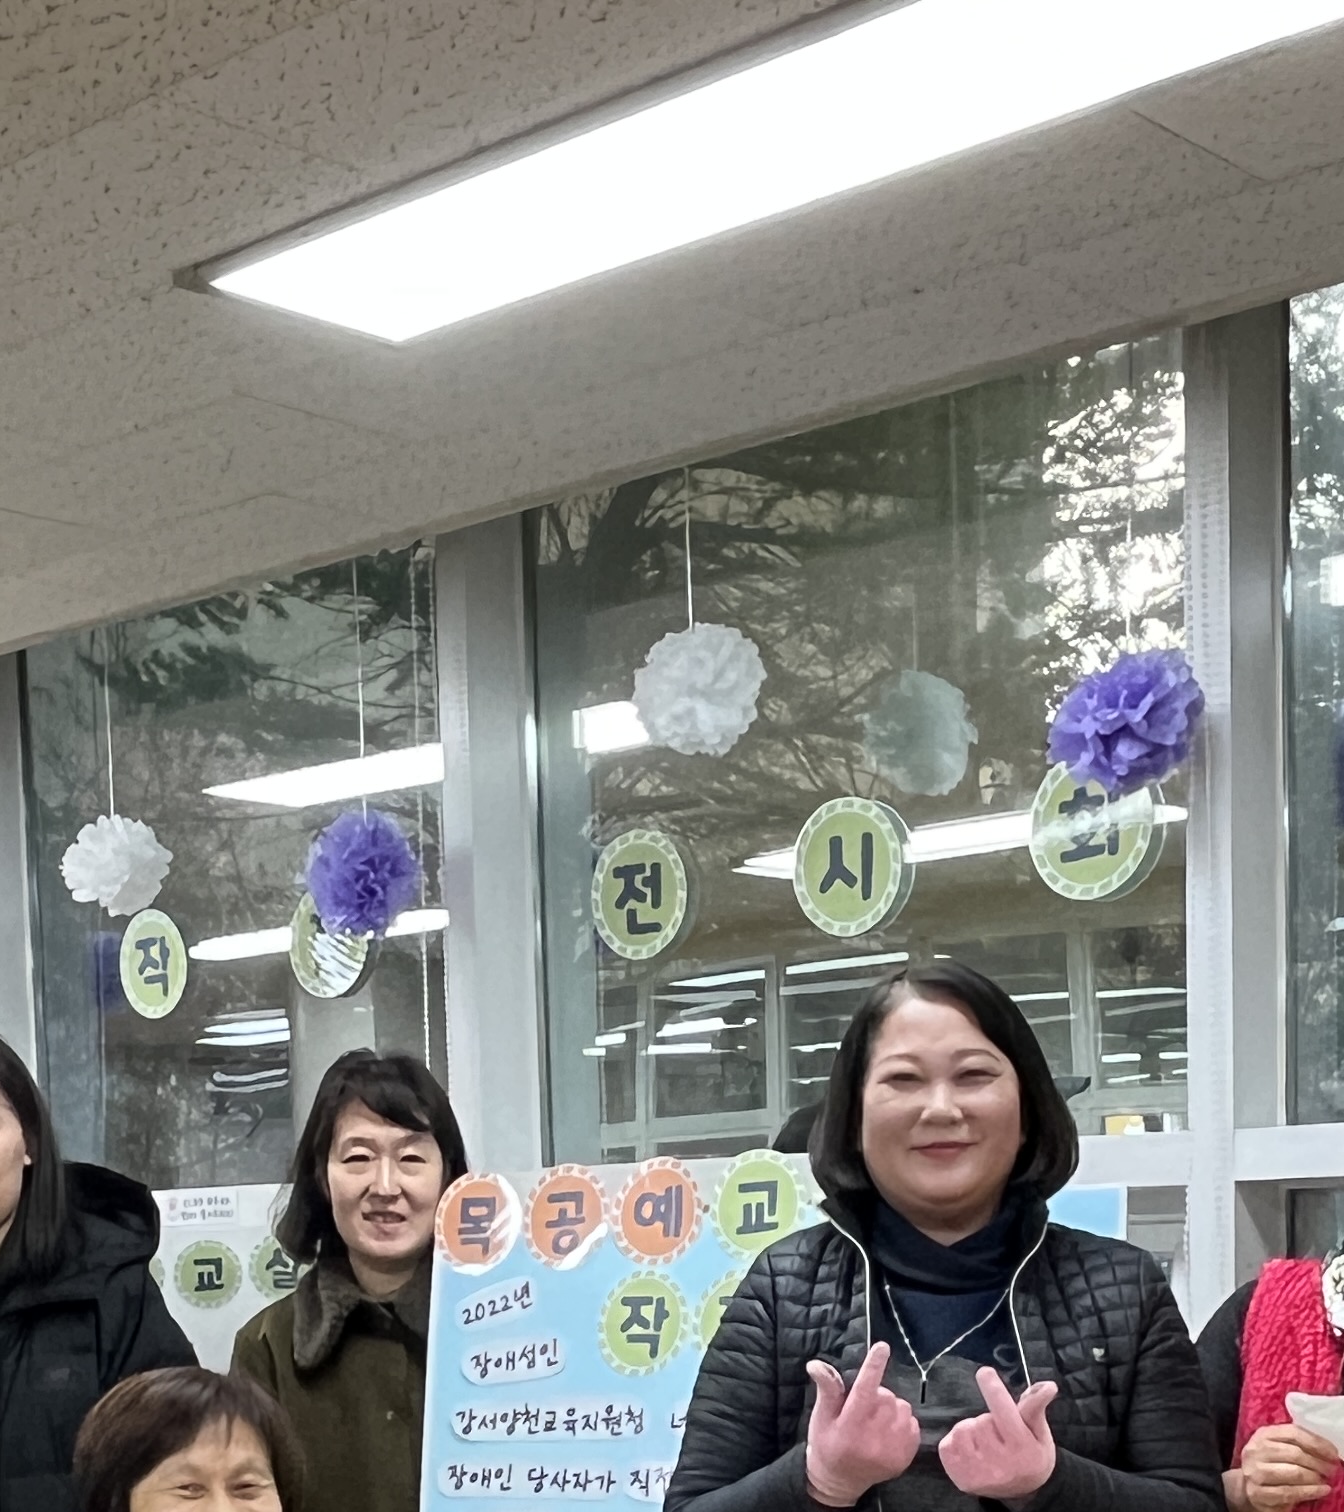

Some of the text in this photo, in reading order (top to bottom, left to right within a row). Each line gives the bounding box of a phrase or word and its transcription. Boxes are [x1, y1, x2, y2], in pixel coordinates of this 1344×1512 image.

[462, 1280, 534, 1326] 2022년
[455, 1402, 645, 1437] 강서양천교육지원청
[447, 1463, 513, 1492] 장애인
[527, 1465, 617, 1494] 당사자가
